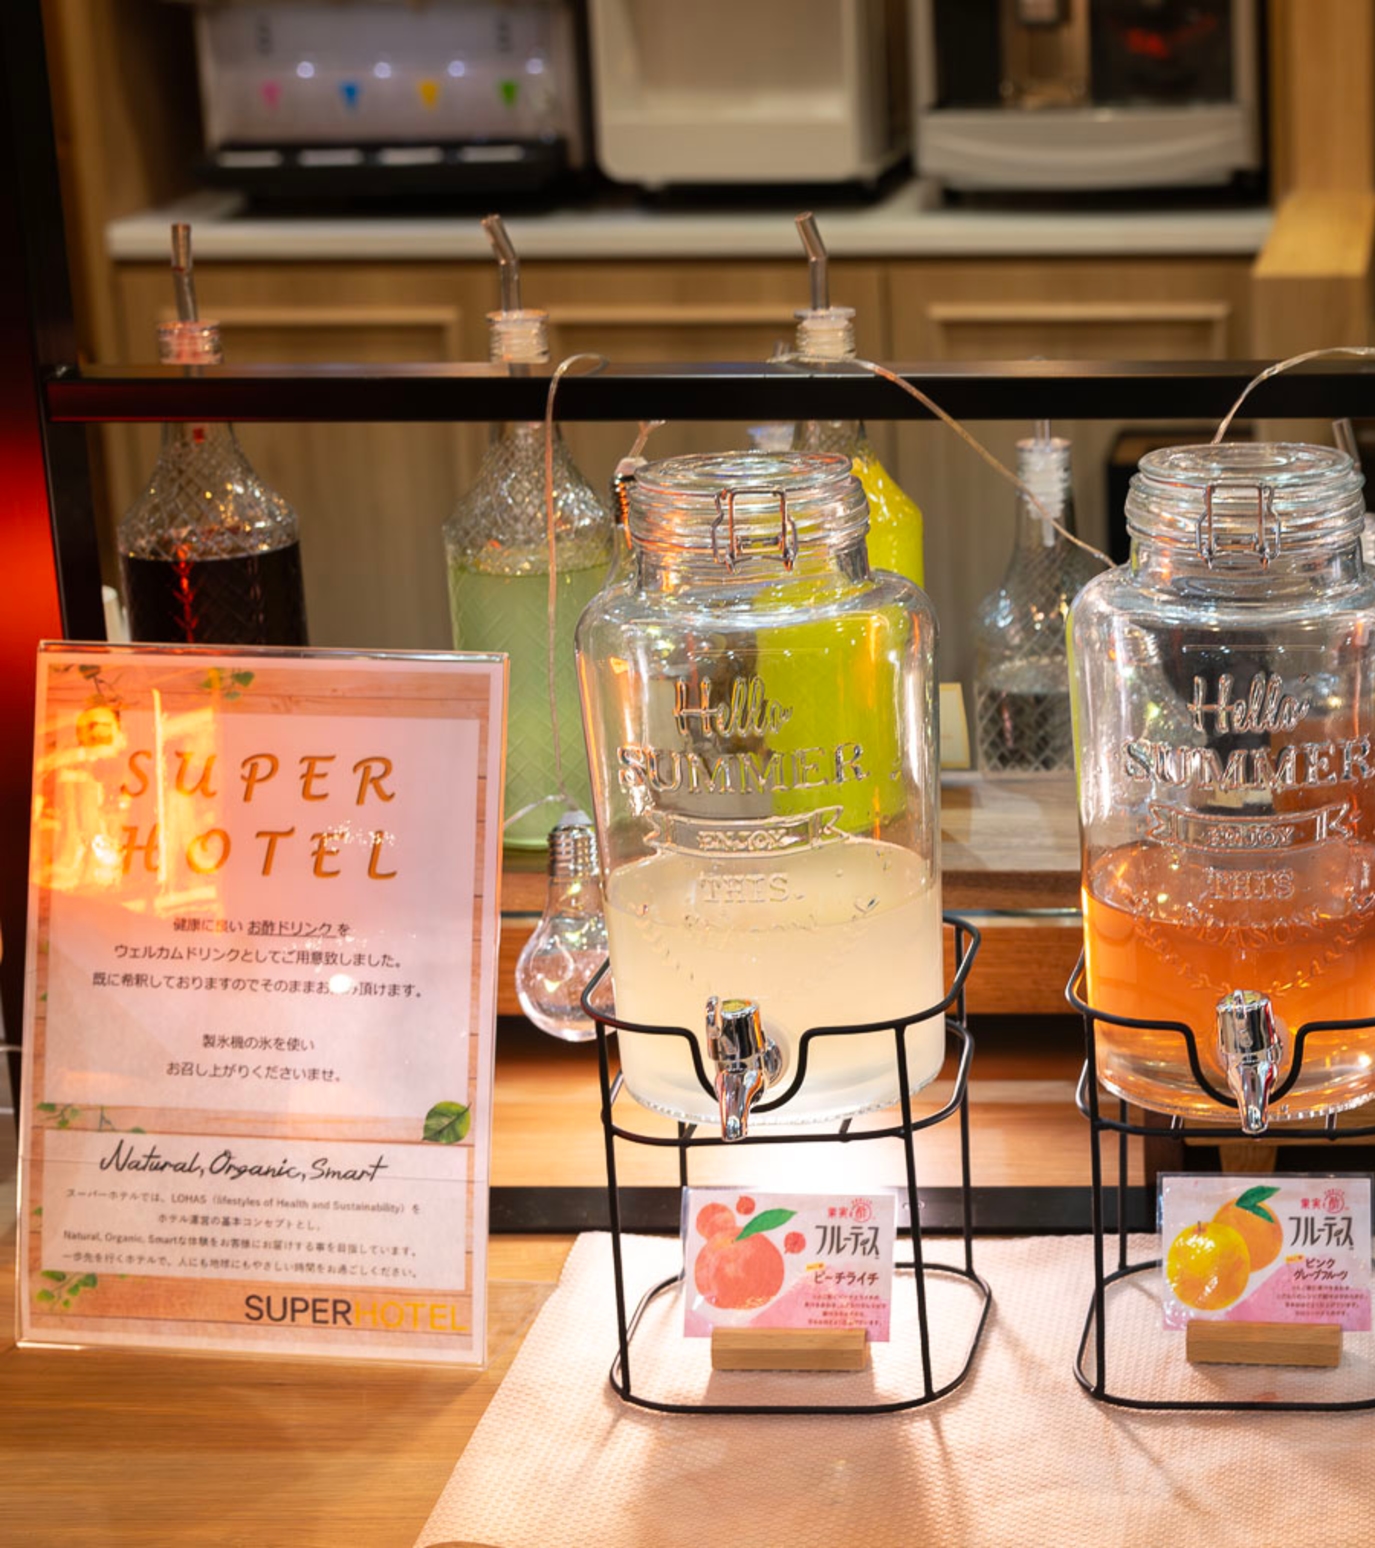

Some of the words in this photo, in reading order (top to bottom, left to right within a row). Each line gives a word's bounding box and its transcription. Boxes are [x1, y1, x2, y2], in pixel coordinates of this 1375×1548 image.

[673, 675, 793, 737] Hello
[1187, 672, 1310, 734] Hello
[119, 750, 396, 806] SUPER
[617, 742, 870, 794] SUMMER
[119, 821, 397, 880] HOTEL
[114, 944, 402, 969] ウェルカムドリンクとしてご用意致しました。
[202, 1034, 315, 1052] 製氷機の氷を使い
[166, 1061, 341, 1083] お召し上がりくださいませ。
[276, 1199, 309, 1209] Health
[311, 1202, 331, 1210] and
[815, 1224, 881, 1257] フルーティス
[1288, 1216, 1355, 1247] フルーティス
